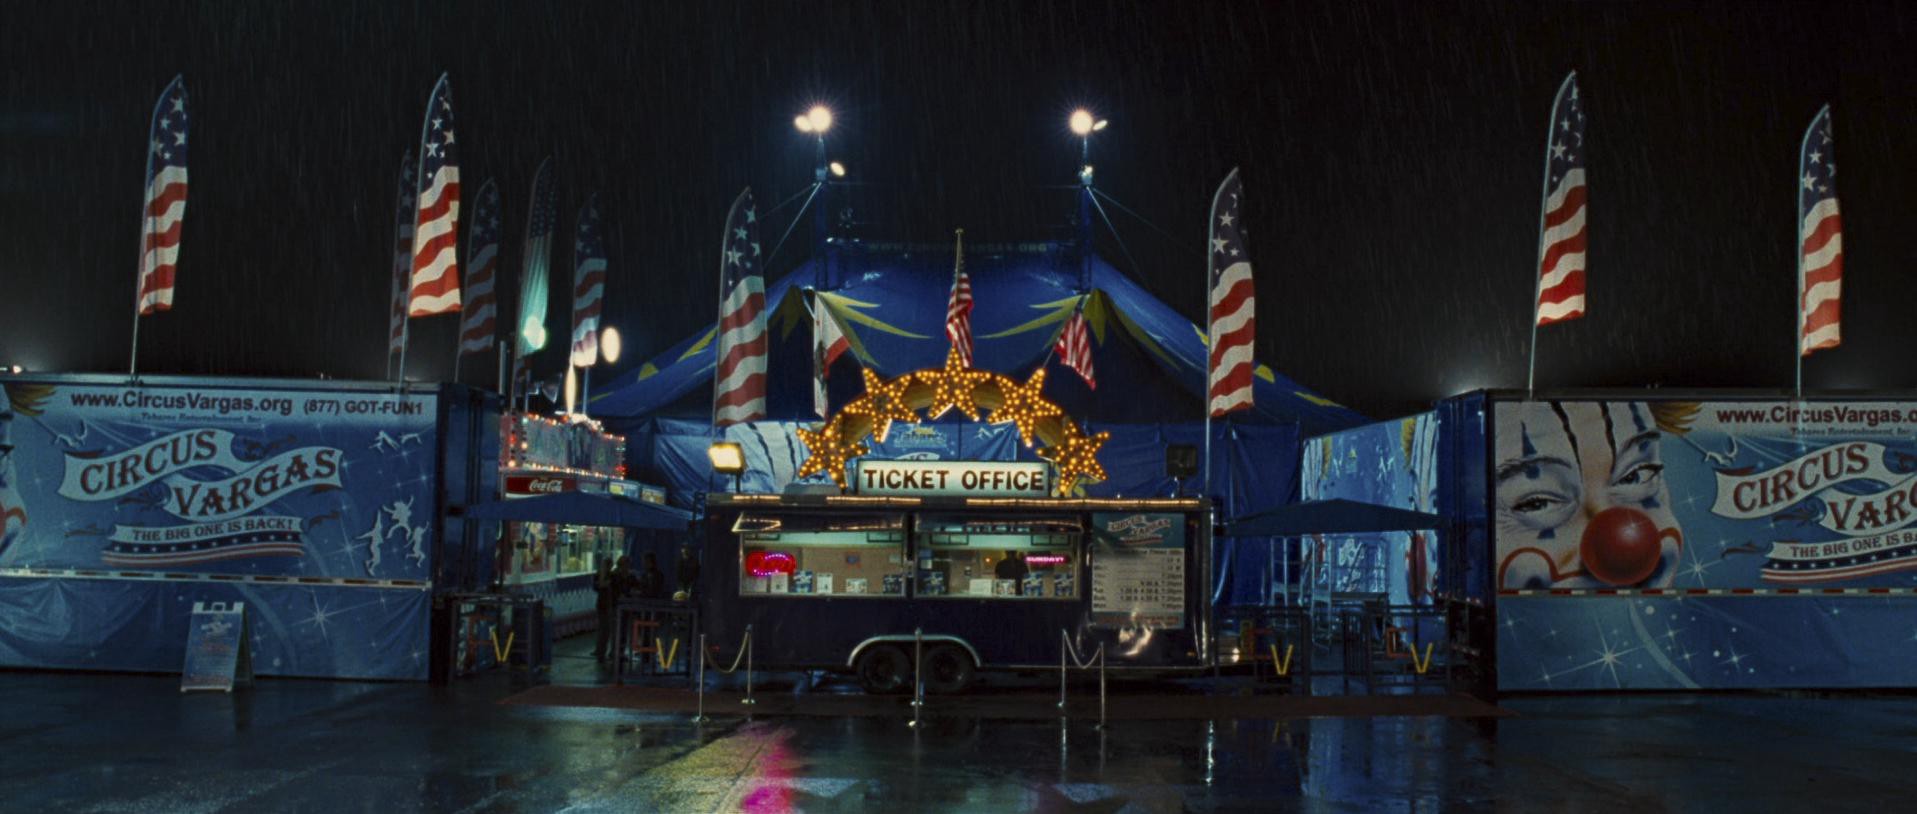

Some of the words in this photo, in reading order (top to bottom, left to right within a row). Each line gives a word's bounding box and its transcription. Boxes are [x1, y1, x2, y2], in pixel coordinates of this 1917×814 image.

[71, 390, 292, 415] www.CircusVargas.org
[304, 399, 340, 416] (877)
[344, 400, 422, 414] GOT-FUN1
[80, 431, 217, 495] CIRCUS
[173, 450, 337, 517] VARGAS
[864, 469, 949, 489] TICKET
[962, 470, 1044, 490] OFFICE
[1733, 444, 1870, 512] CIRCUS
[132, 529, 160, 541] THE
[165, 526, 190, 539] BIG
[195, 523, 222, 538] ONE
[228, 520, 242, 533] IS
[246, 518, 292, 531] BACK!
[1790, 546, 1820, 557] THE
[1823, 543, 1849, 556] BIG
[1852, 537, 1881, 551] ONE
[1886, 533, 1899, 545] IS
